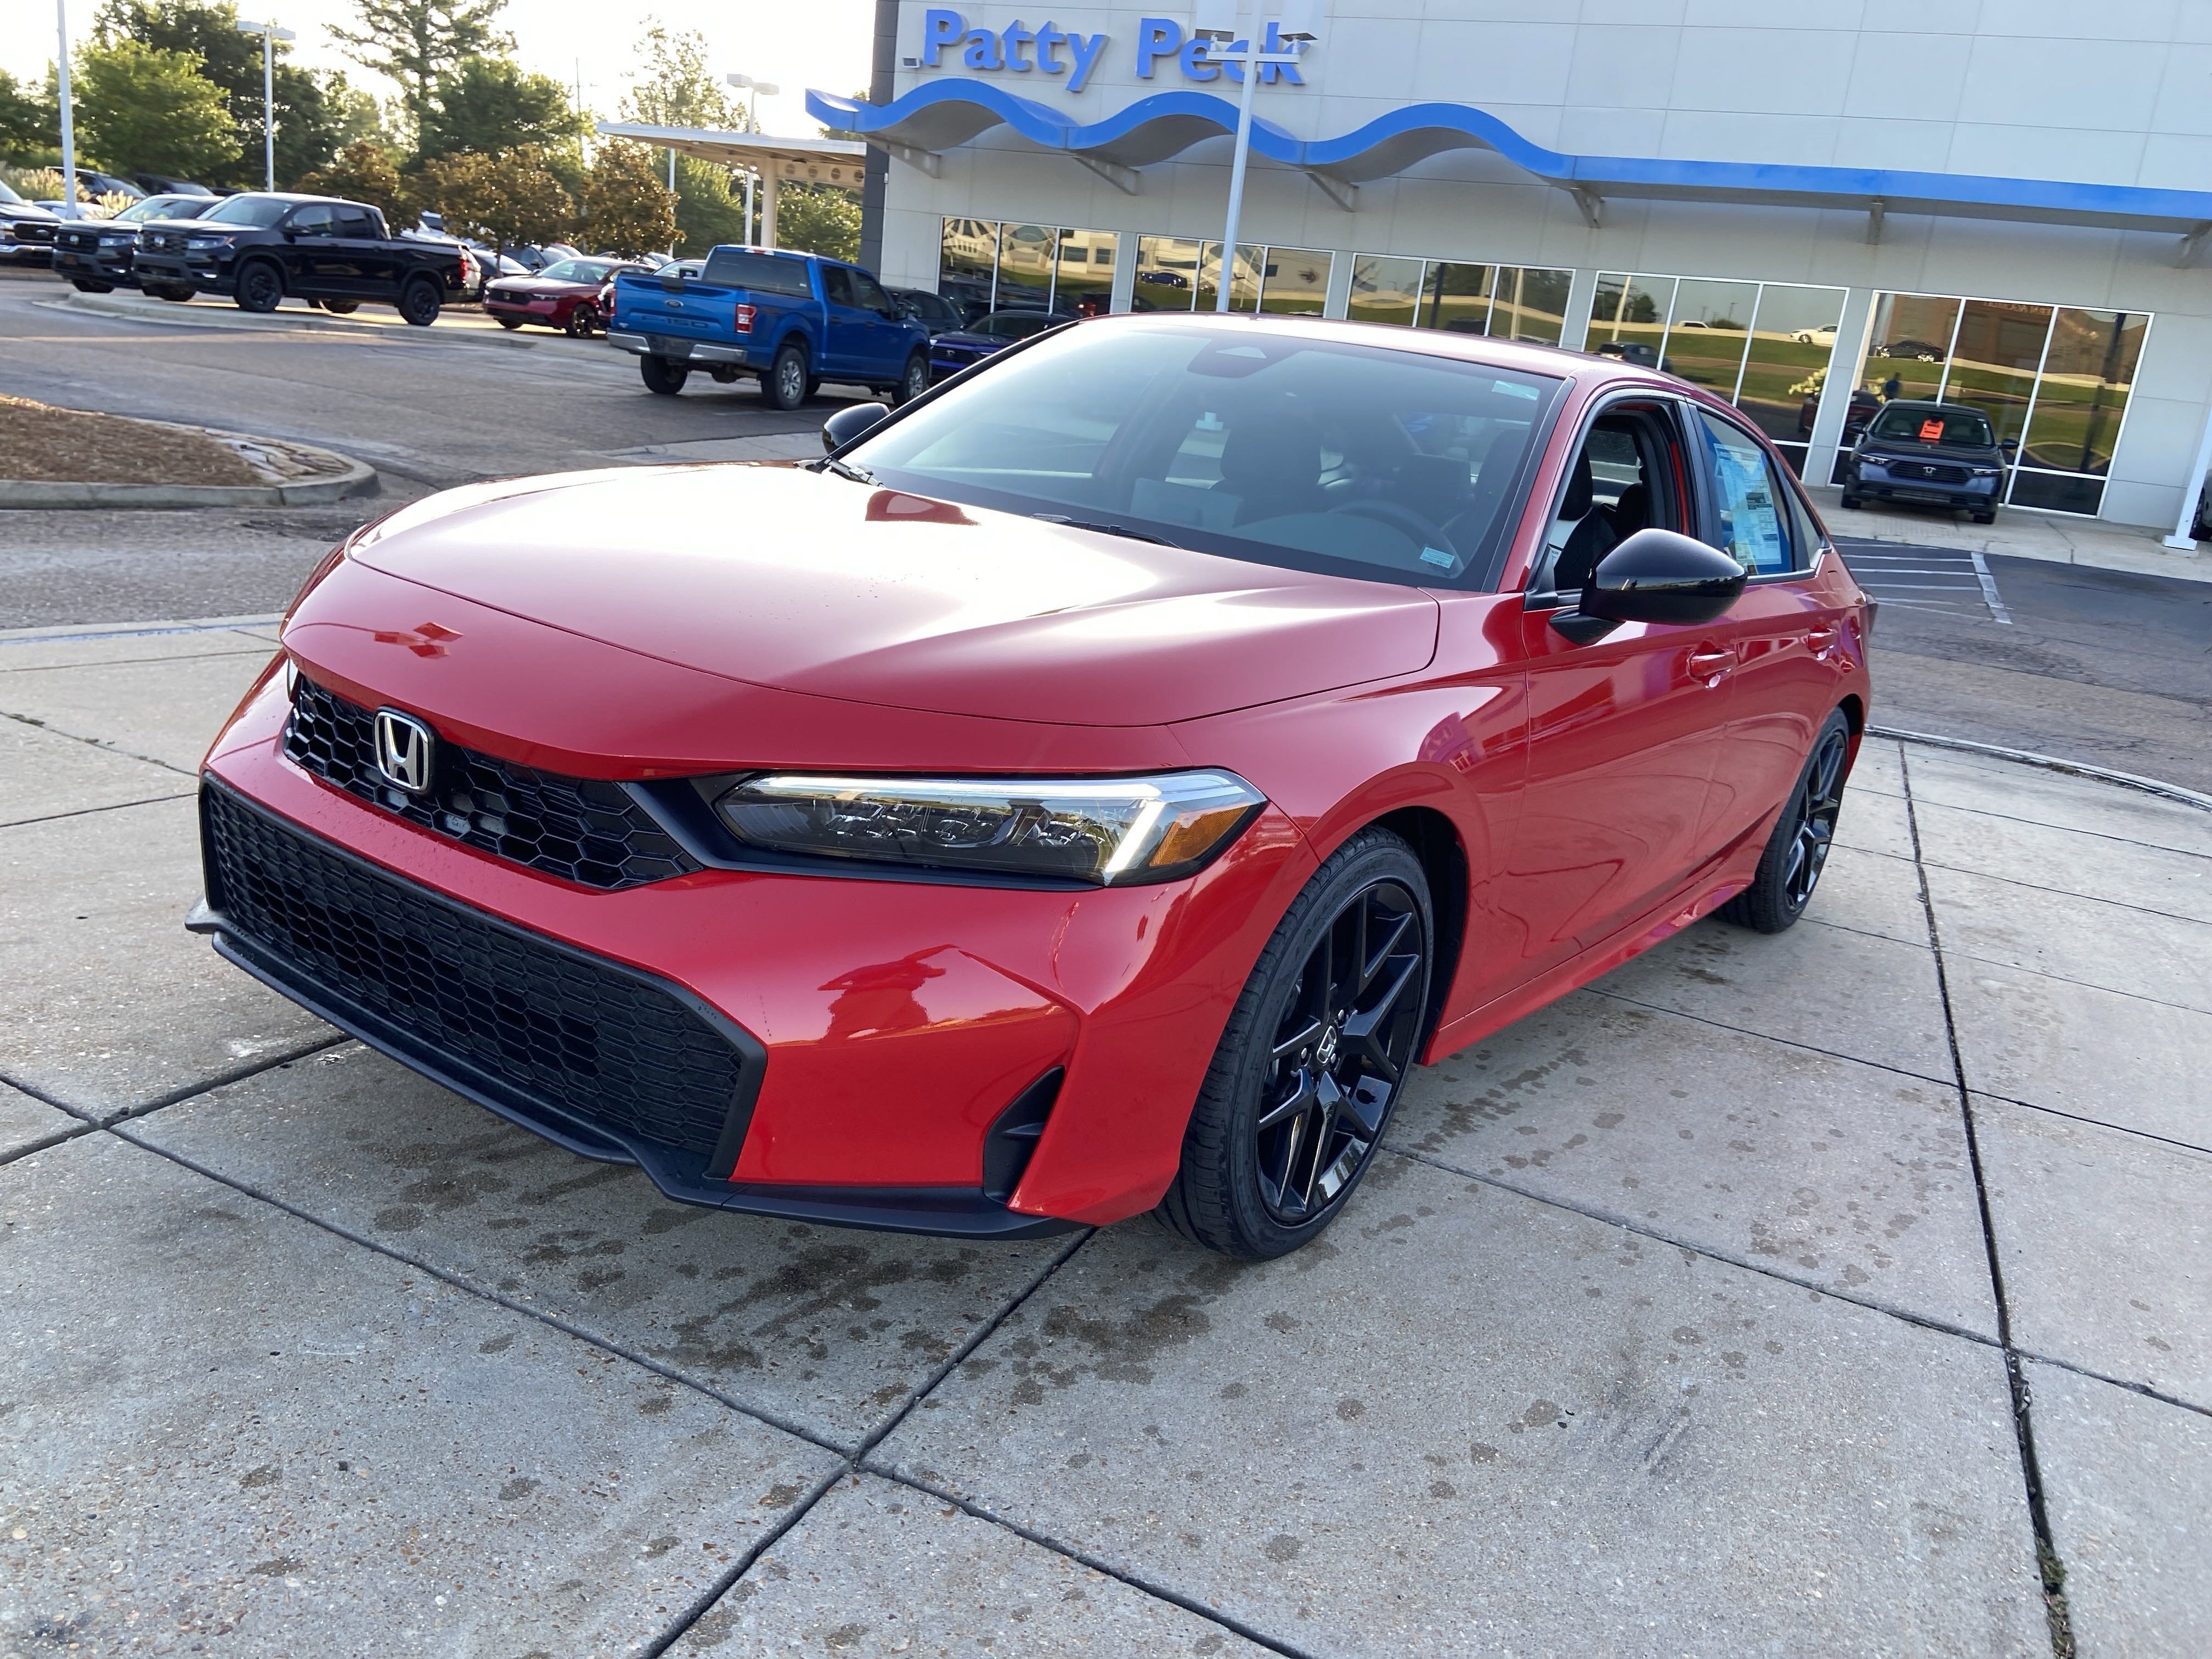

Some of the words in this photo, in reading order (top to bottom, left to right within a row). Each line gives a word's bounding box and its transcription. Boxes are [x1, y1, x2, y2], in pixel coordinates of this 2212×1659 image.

[923, 9, 1109, 92] Patty
[1136, 18, 1310, 84] Peck
[642, 315, 709, 329] F-150
